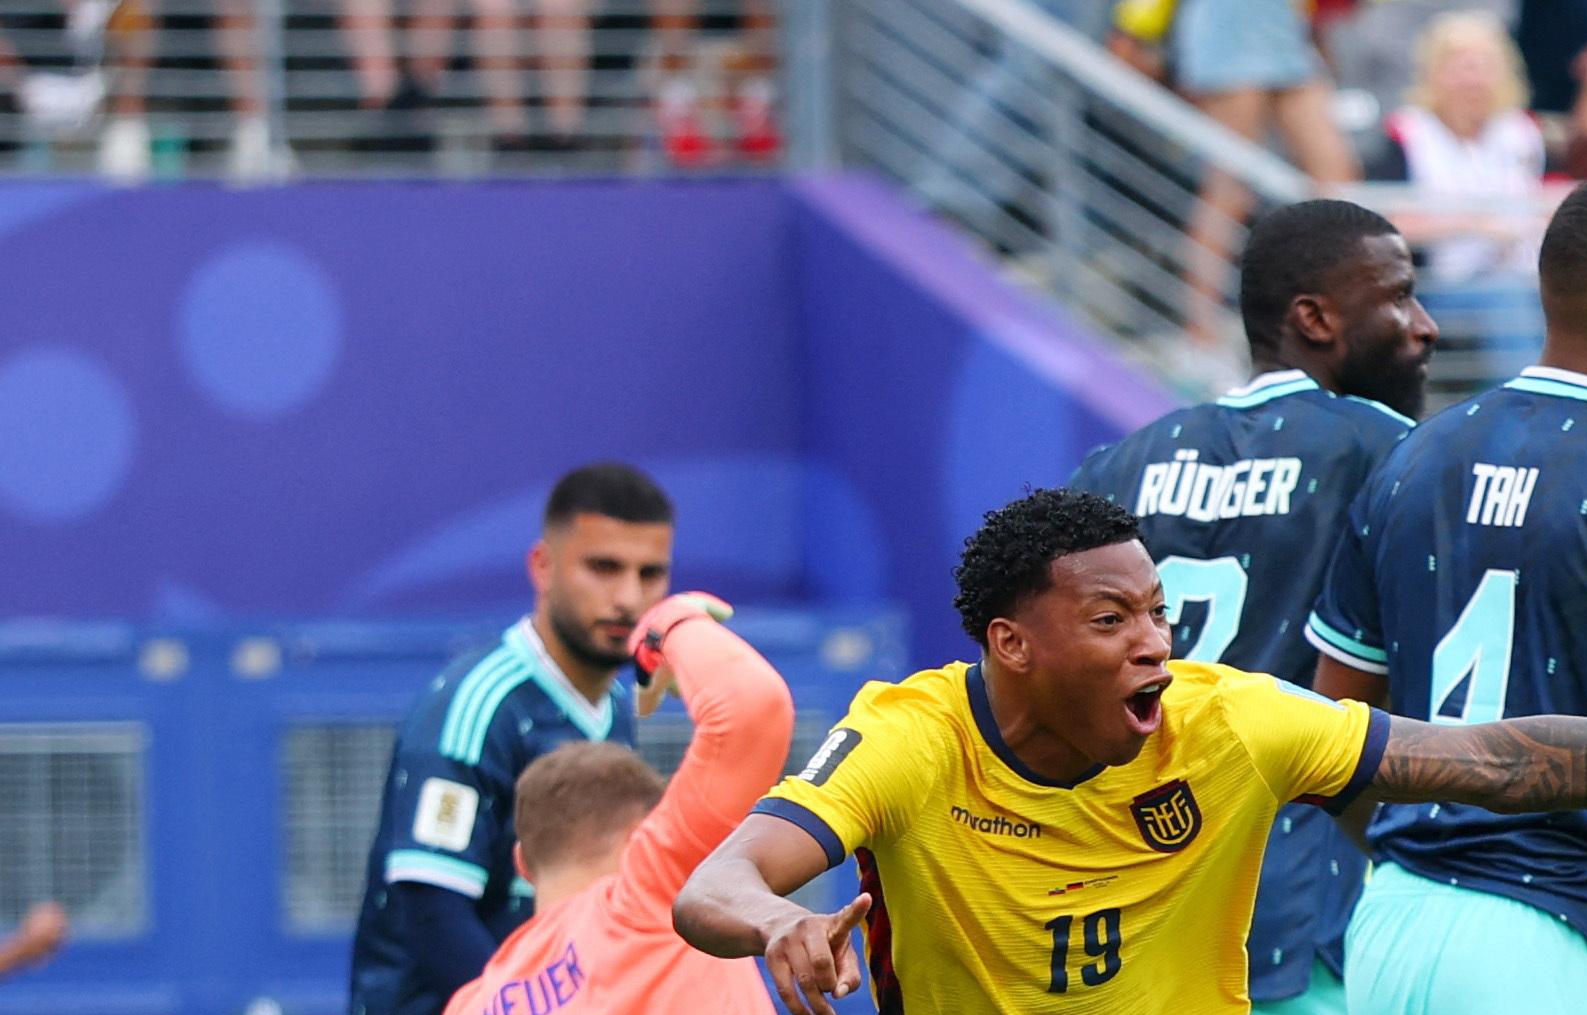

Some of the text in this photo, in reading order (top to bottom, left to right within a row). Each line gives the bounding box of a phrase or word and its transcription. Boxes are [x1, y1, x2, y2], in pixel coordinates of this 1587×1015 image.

[1466, 462, 1540, 528] TAH
[1430, 568, 1517, 724] 4
[1044, 907, 1122, 994] 19
